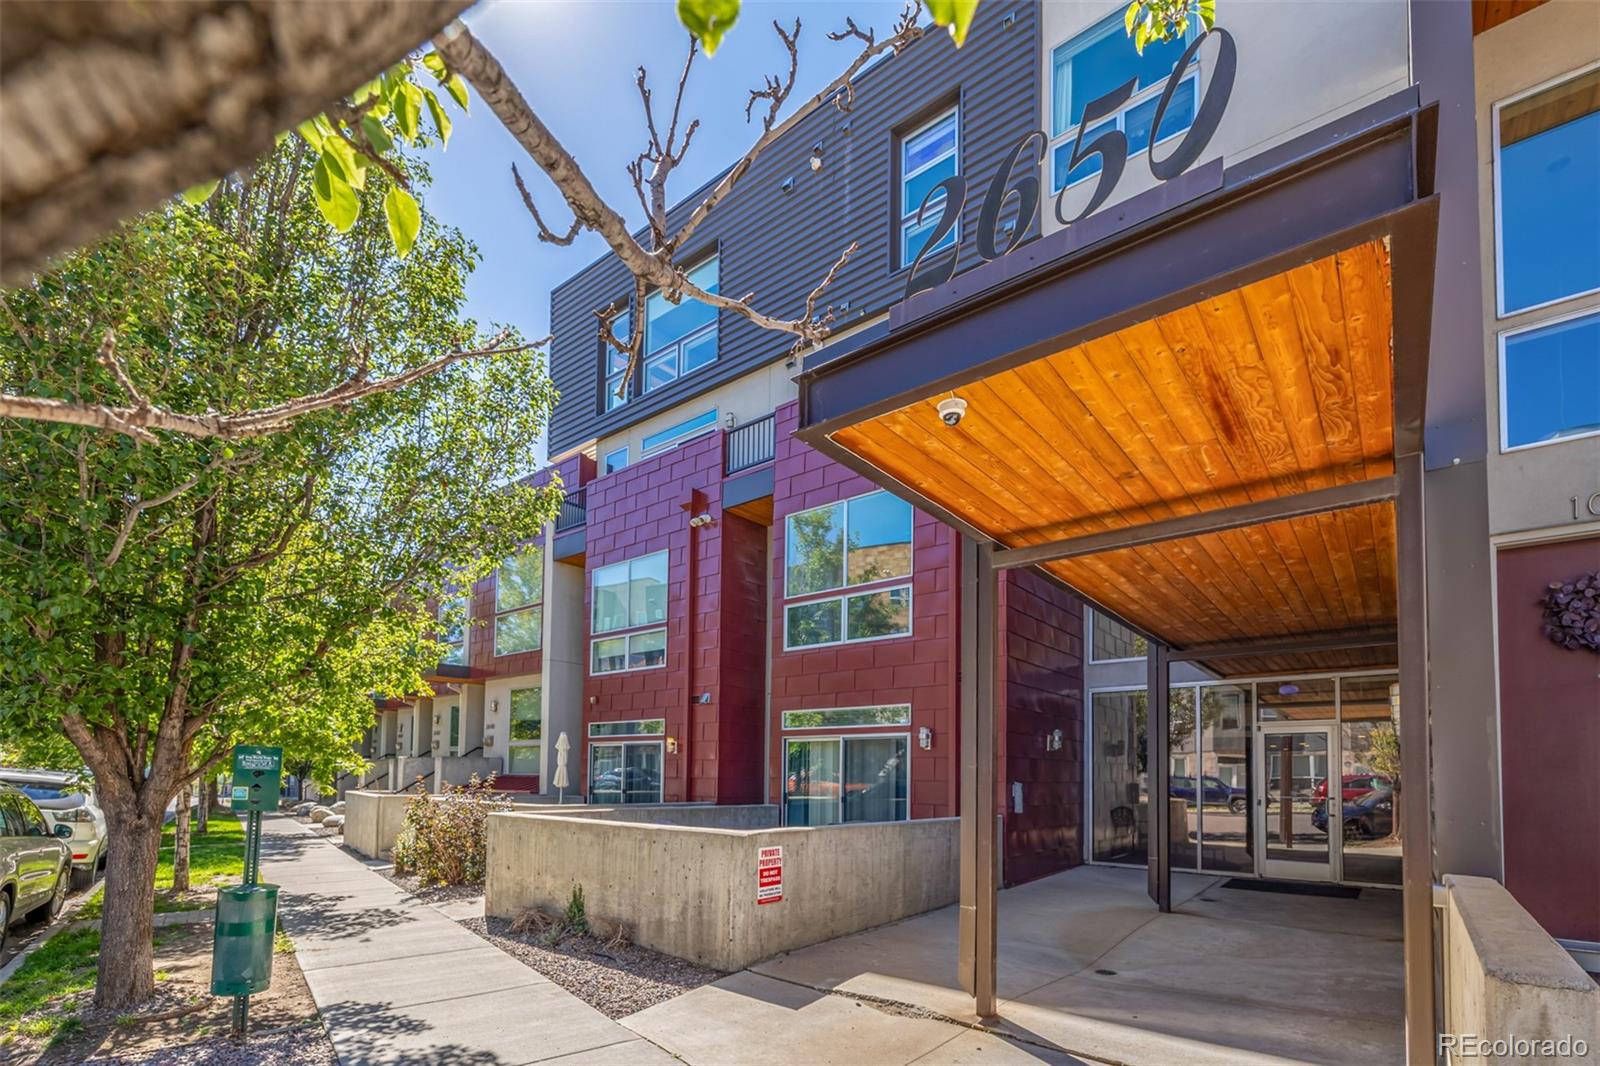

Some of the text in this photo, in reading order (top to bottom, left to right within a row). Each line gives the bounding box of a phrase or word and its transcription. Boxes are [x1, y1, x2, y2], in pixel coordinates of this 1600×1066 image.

[904, 26, 1237, 300] 2650
[761, 848, 780, 858] PRIVATE
[759, 857, 782, 867] PROPERTY
